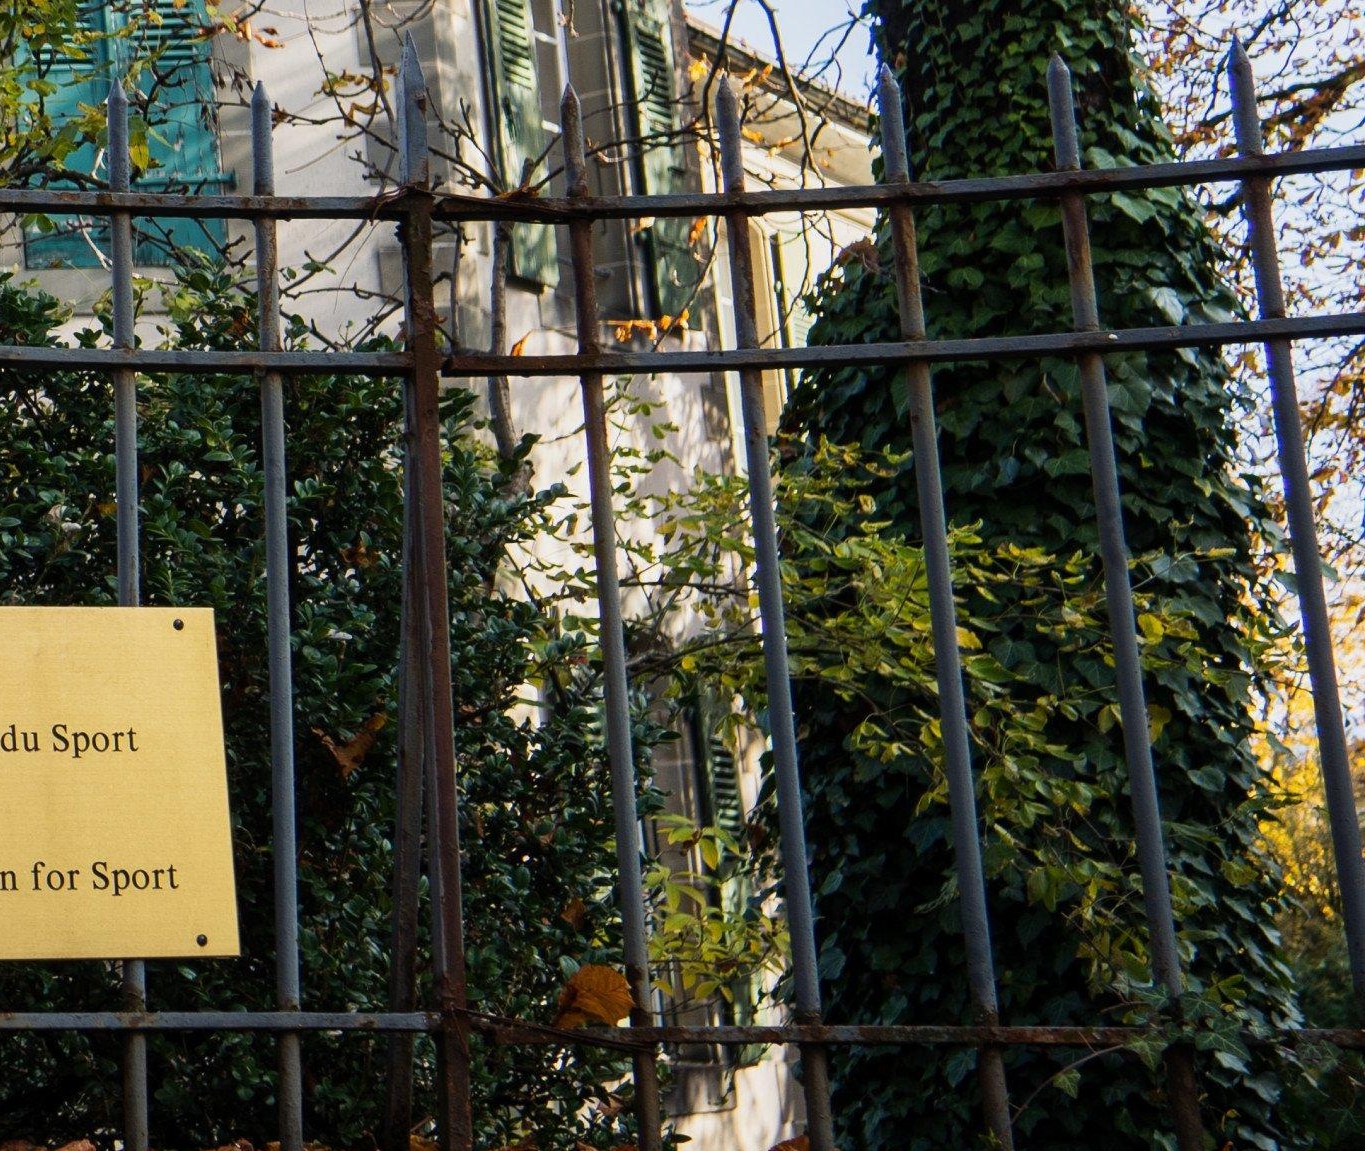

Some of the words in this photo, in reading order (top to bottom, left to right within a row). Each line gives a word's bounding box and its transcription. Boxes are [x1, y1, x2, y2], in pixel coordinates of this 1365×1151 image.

[0, 724, 40, 752] du
[51, 724, 139, 759] Sport
[31, 861, 80, 891] for
[91, 861, 179, 897] Sport
